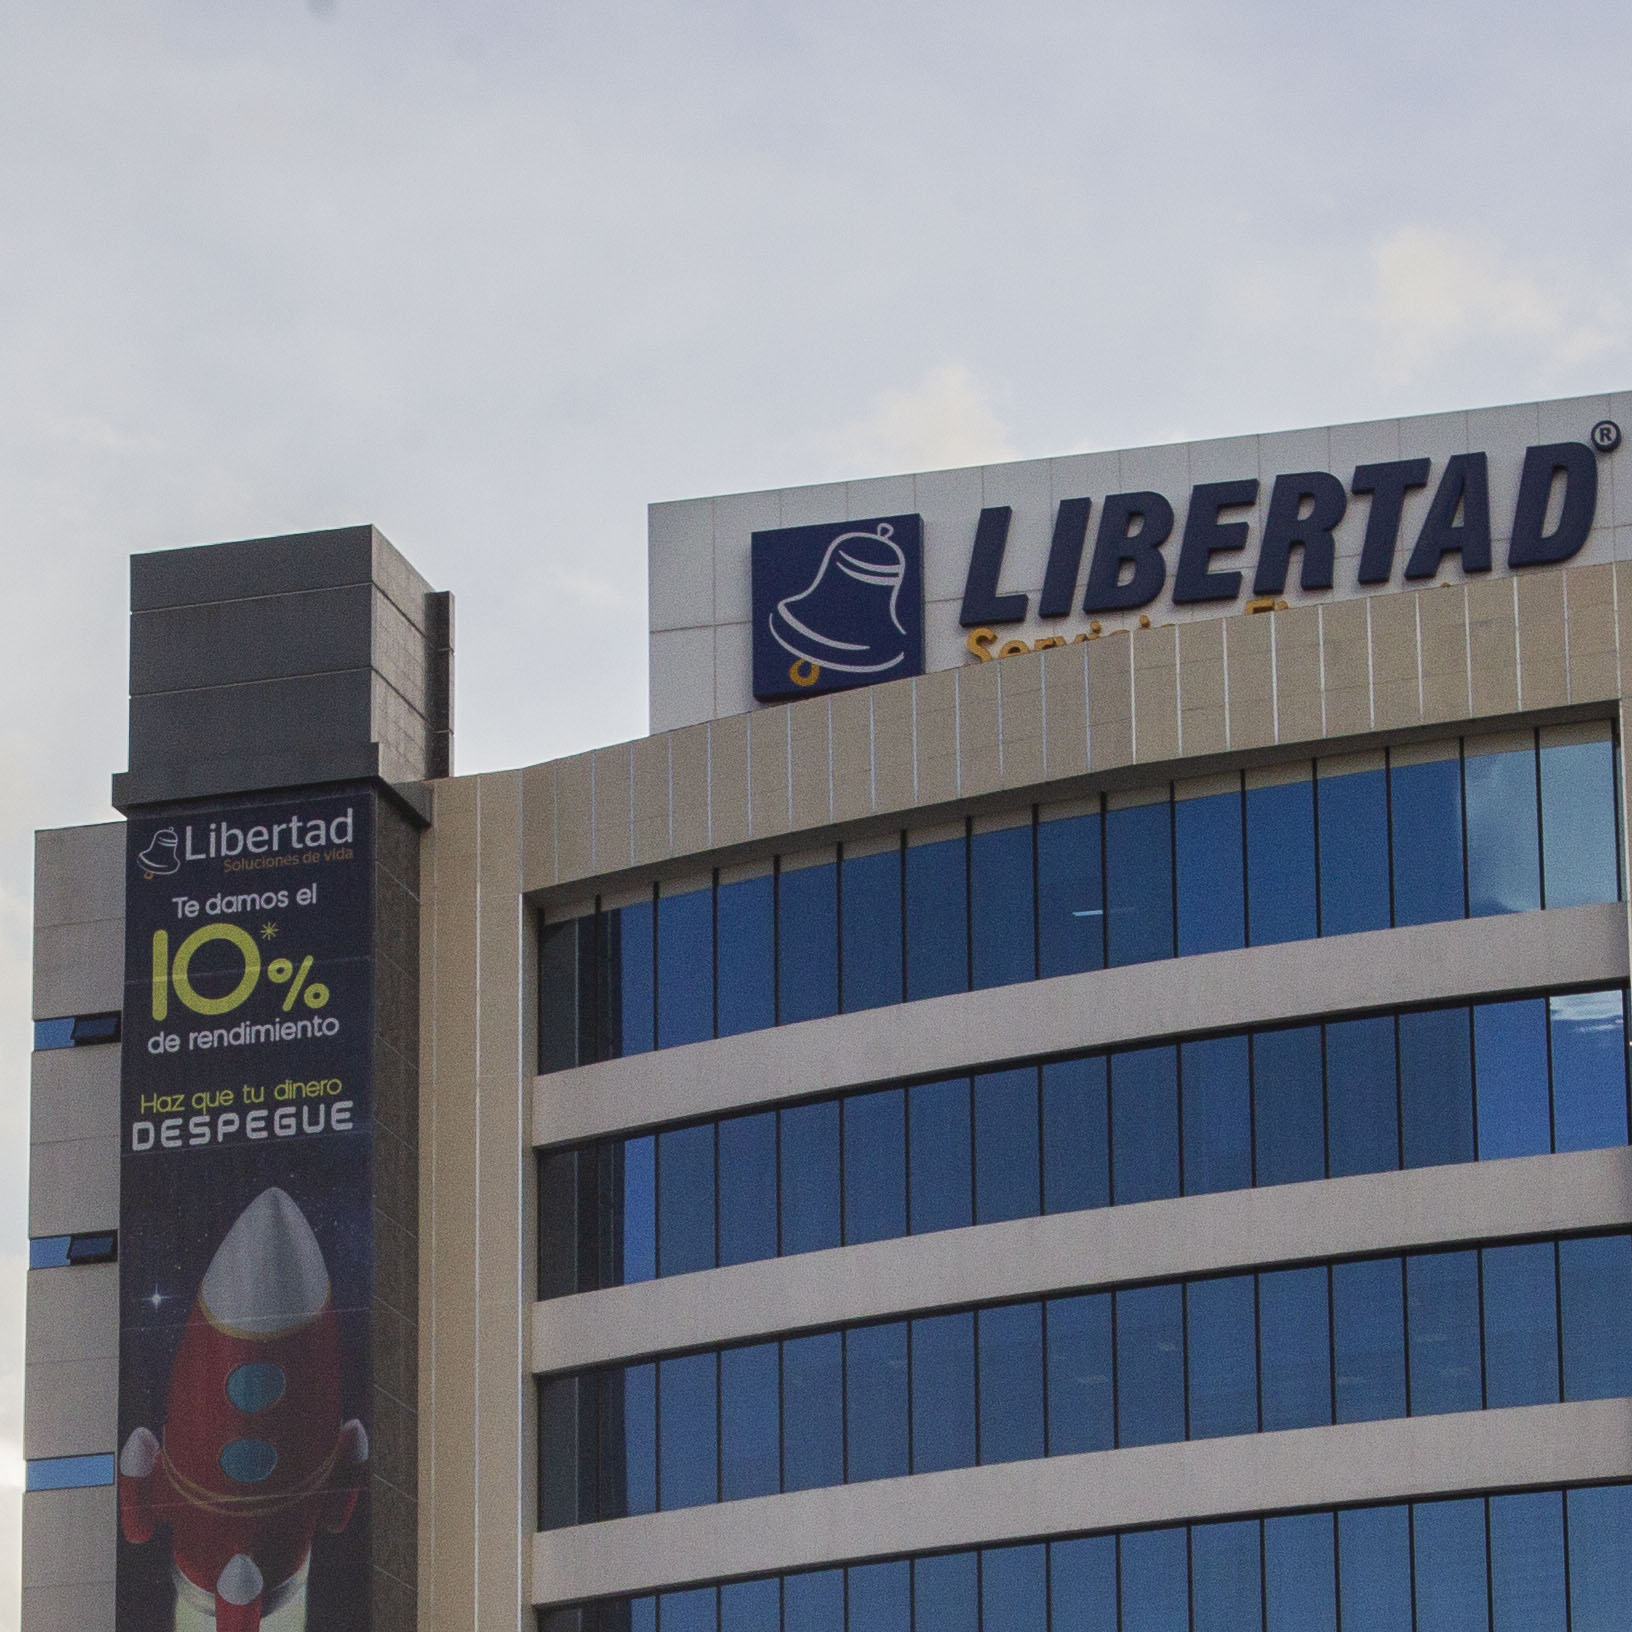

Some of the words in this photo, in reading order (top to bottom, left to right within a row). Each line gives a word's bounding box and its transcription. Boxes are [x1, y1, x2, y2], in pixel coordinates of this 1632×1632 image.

[185, 808, 353, 861] Libertad
[223, 854, 300, 873] Soluciones
[302, 850, 321, 863] de
[323, 847, 353, 861] vida
[172, 896, 199, 918] Te
[205, 892, 289, 916] damos
[296, 883, 317, 905] el
[147, 1031, 180, 1054] de
[189, 1015, 340, 1050] rendimiento
[140, 1093, 185, 1114] Haz
[192, 1086, 234, 1114] que
[243, 1082, 265, 1104] tu
[274, 1077, 342, 1100] dinero
[132, 1100, 354, 1151] DESPEGUE
